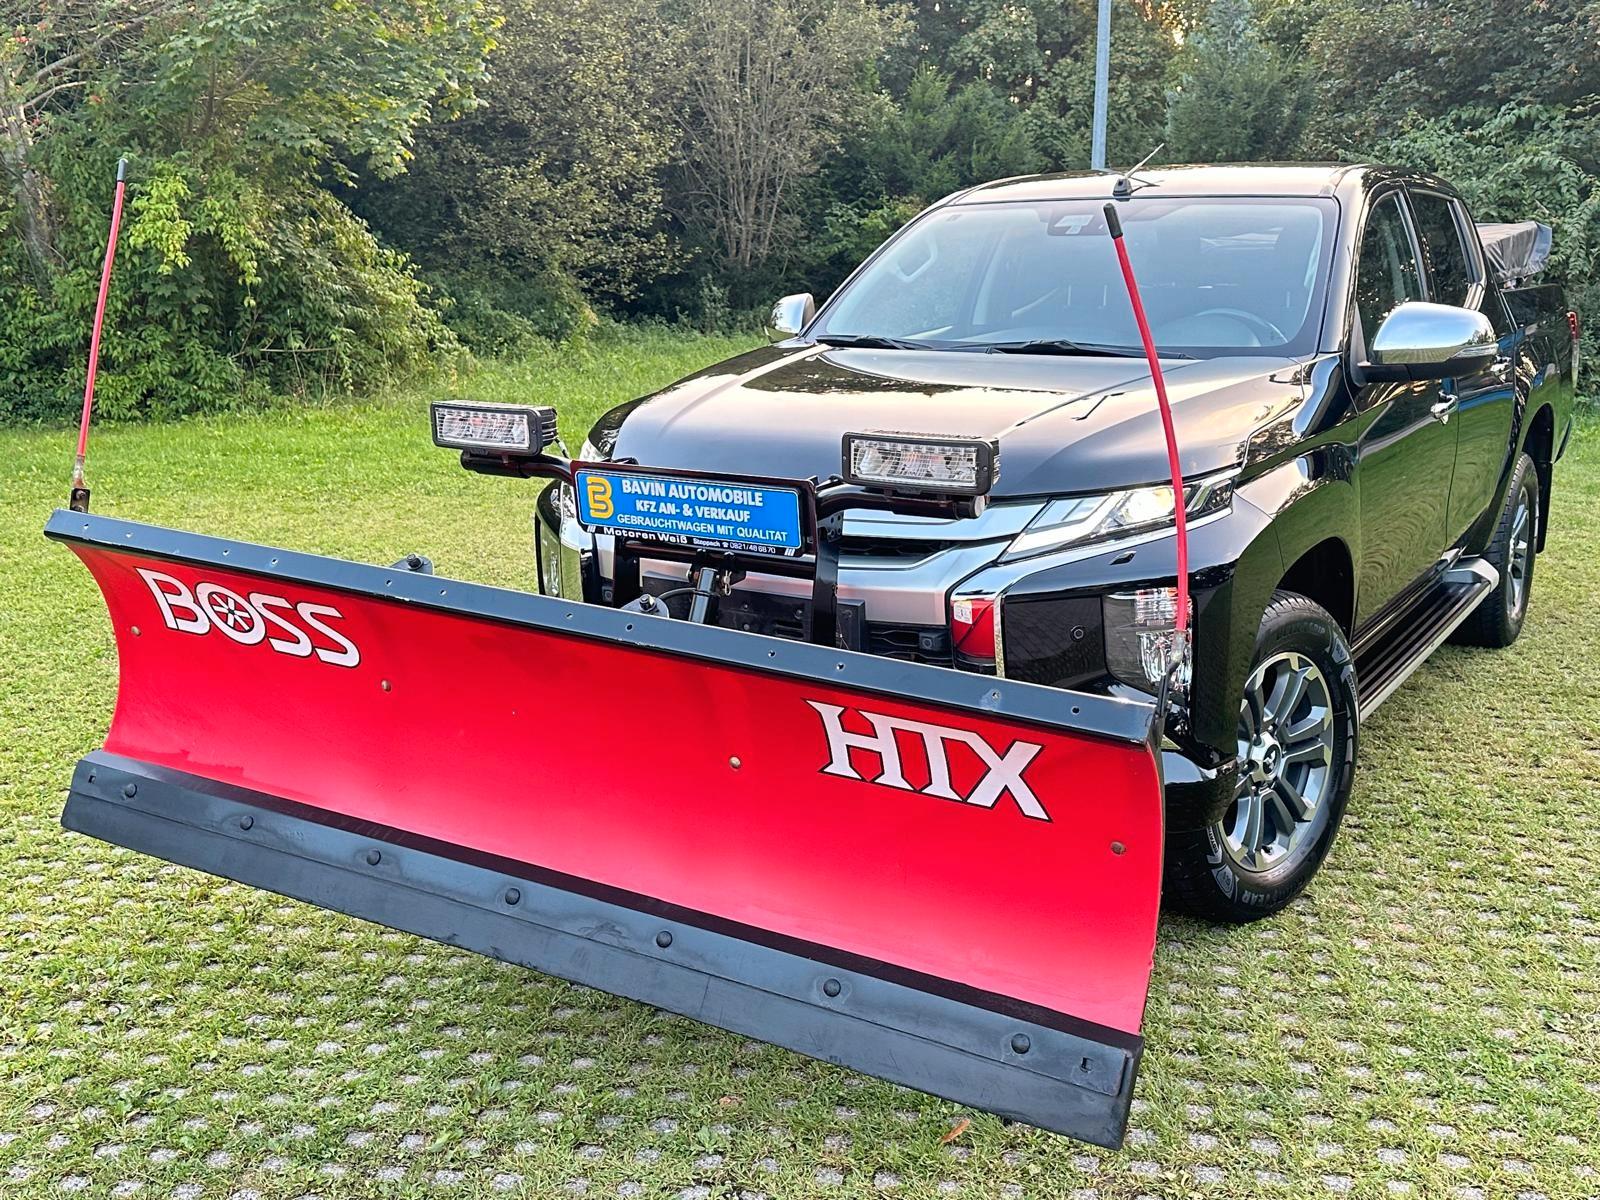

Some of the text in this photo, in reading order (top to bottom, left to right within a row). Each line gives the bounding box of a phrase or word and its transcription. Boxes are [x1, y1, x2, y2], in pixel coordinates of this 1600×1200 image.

[621, 479, 763, 507] BAVIN AUTOMOBILE
[635, 499, 751, 523] KFZ AN- & VERKAUF
[603, 527, 656, 540] Motoren
[657, 533, 688, 544] Weiß
[616, 513, 715, 534] GEBRAUCHTWAGEN
[716, 524, 735, 536] MIT
[134, 566, 361, 668] BOSS
[802, 698, 1052, 822] HTX
